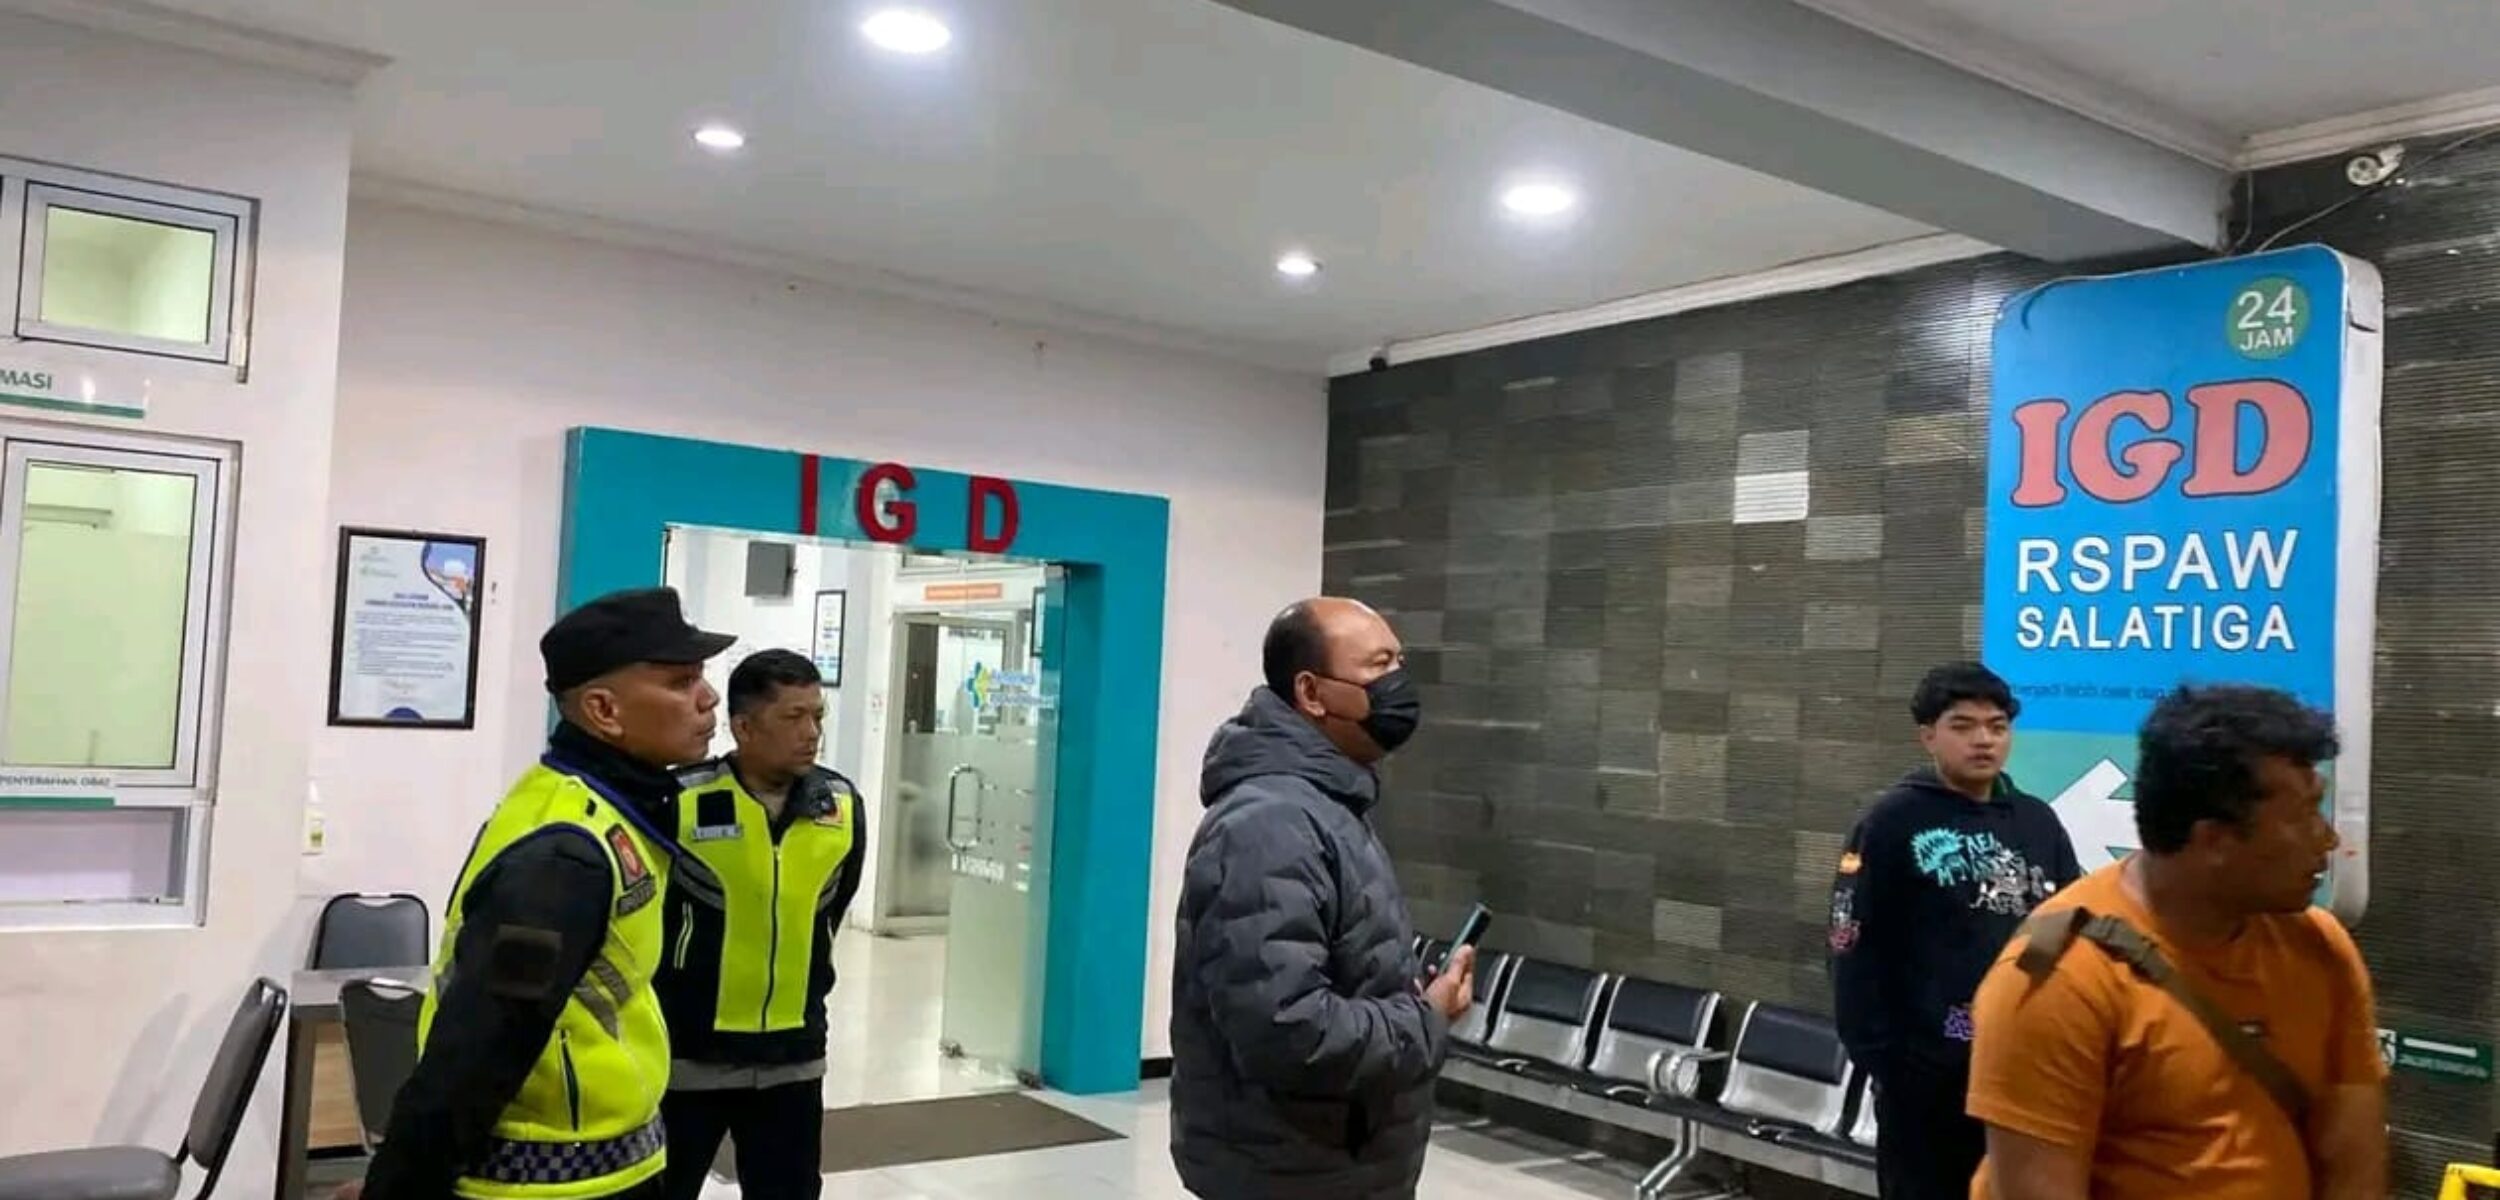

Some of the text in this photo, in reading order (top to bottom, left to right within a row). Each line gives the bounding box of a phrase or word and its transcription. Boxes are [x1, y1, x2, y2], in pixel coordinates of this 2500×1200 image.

[2236, 285, 2298, 330] 24
[2239, 328, 2294, 351] JAM
[2010, 378, 2313, 508] IGD
[800, 453, 1020, 555] IGD
[2016, 528, 2299, 594] RSPAW
[2016, 603, 2298, 652] SALATIGA
